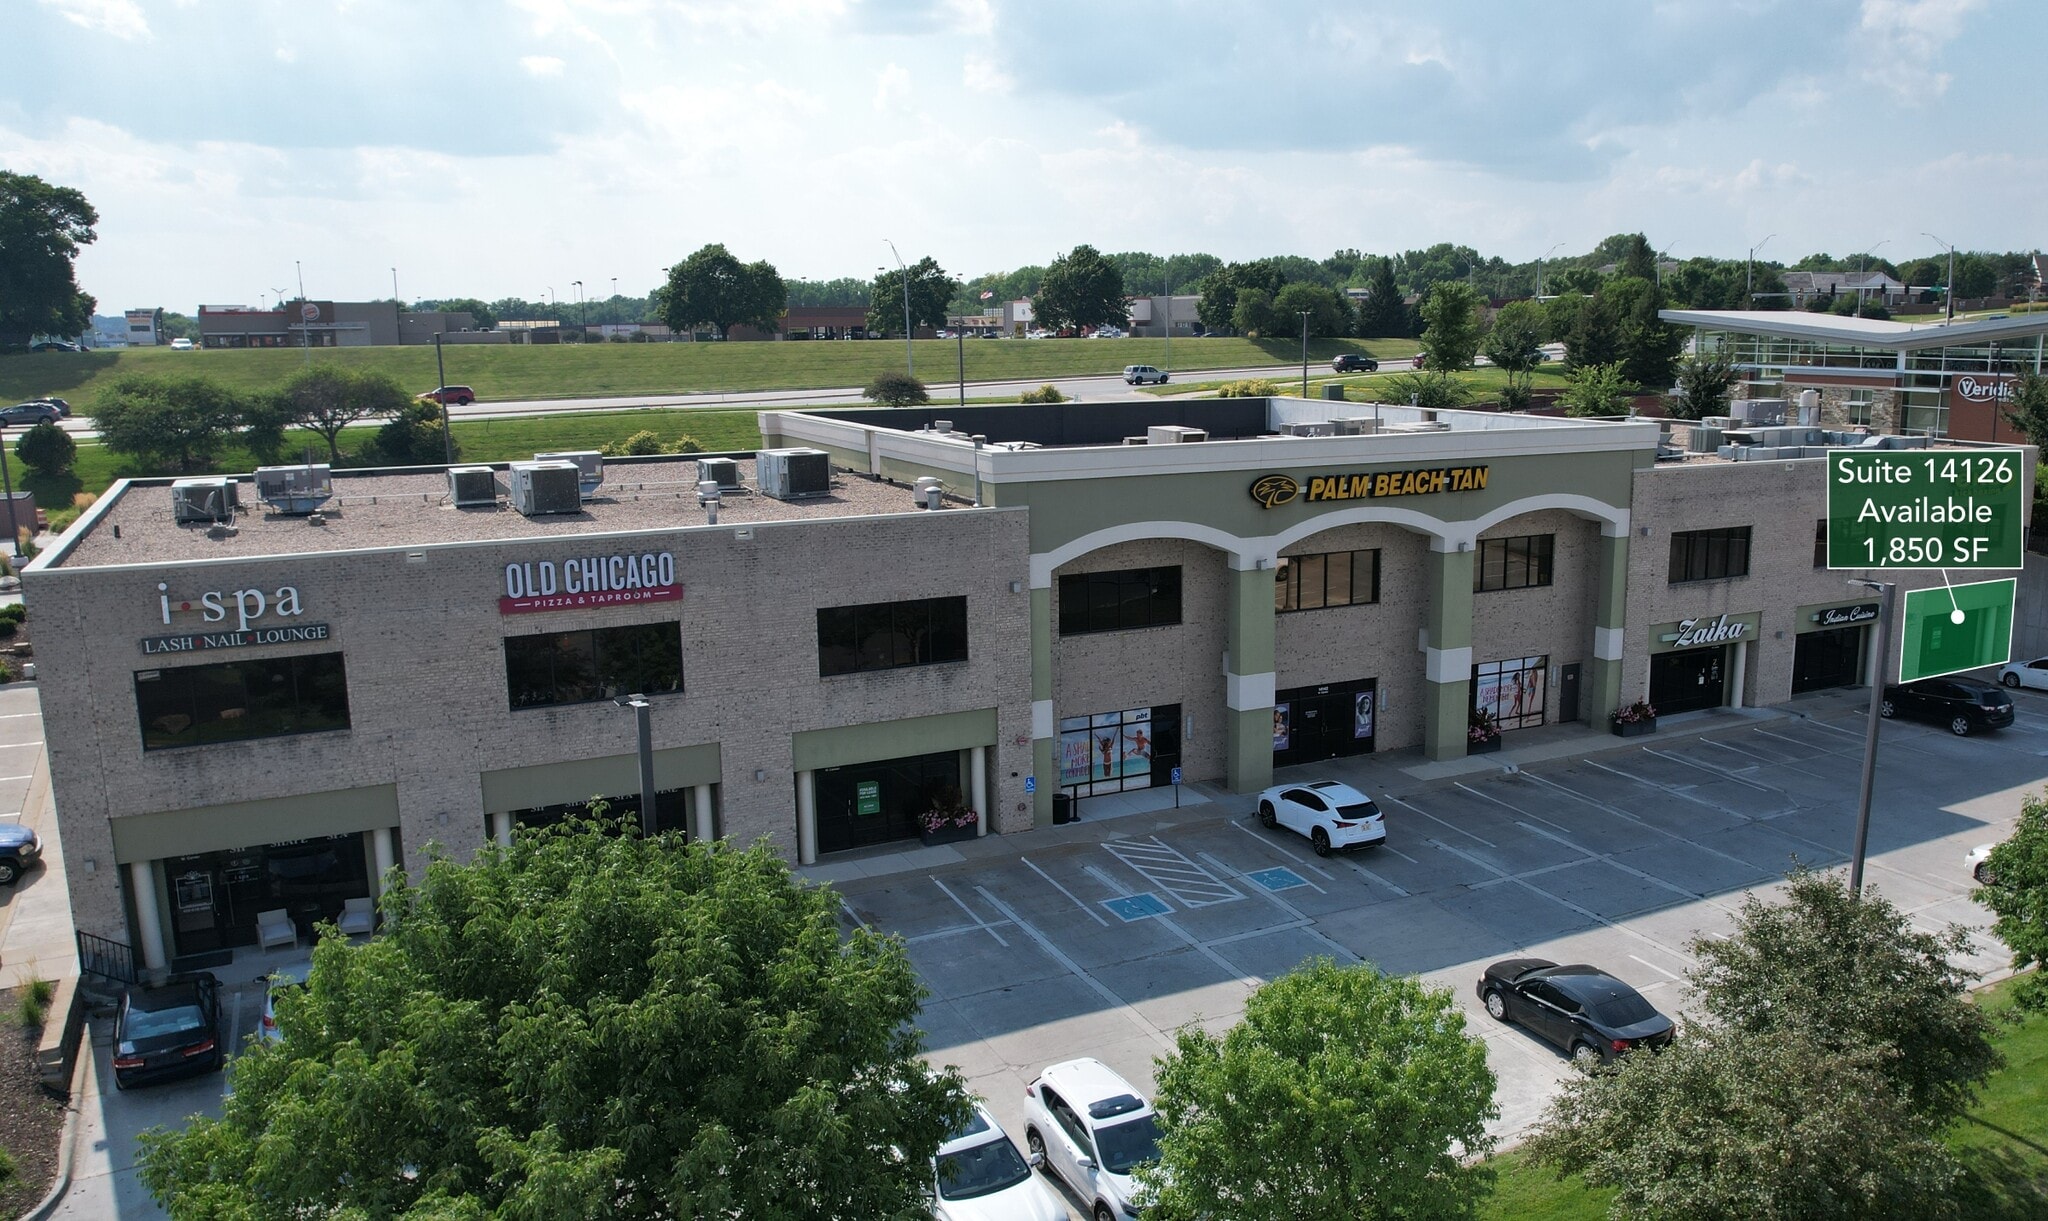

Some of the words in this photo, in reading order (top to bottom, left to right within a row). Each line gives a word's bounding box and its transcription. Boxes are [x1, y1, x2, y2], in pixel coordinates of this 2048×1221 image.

[1309, 476, 1370, 501] PALM
[1374, 469, 1445, 497] BEACH
[1450, 467, 1489, 491] TAN
[506, 561, 557, 599] OLD
[564, 552, 674, 594] CHICAGO
[201, 586, 304, 632] spa
[534, 598, 572, 608] PIZZA
[578, 596, 585, 604] &
[591, 591, 652, 603] TAPROOM
[1674, 614, 1746, 647] Zaika
[1823, 610, 1849, 625] Indian
[1849, 606, 1875, 622] Cuisine
[145, 637, 193, 653] LASH
[203, 633, 247, 648] NAIL
[256, 626, 328, 644] LOUNGE
[1135, 712, 1148, 720] pbt
